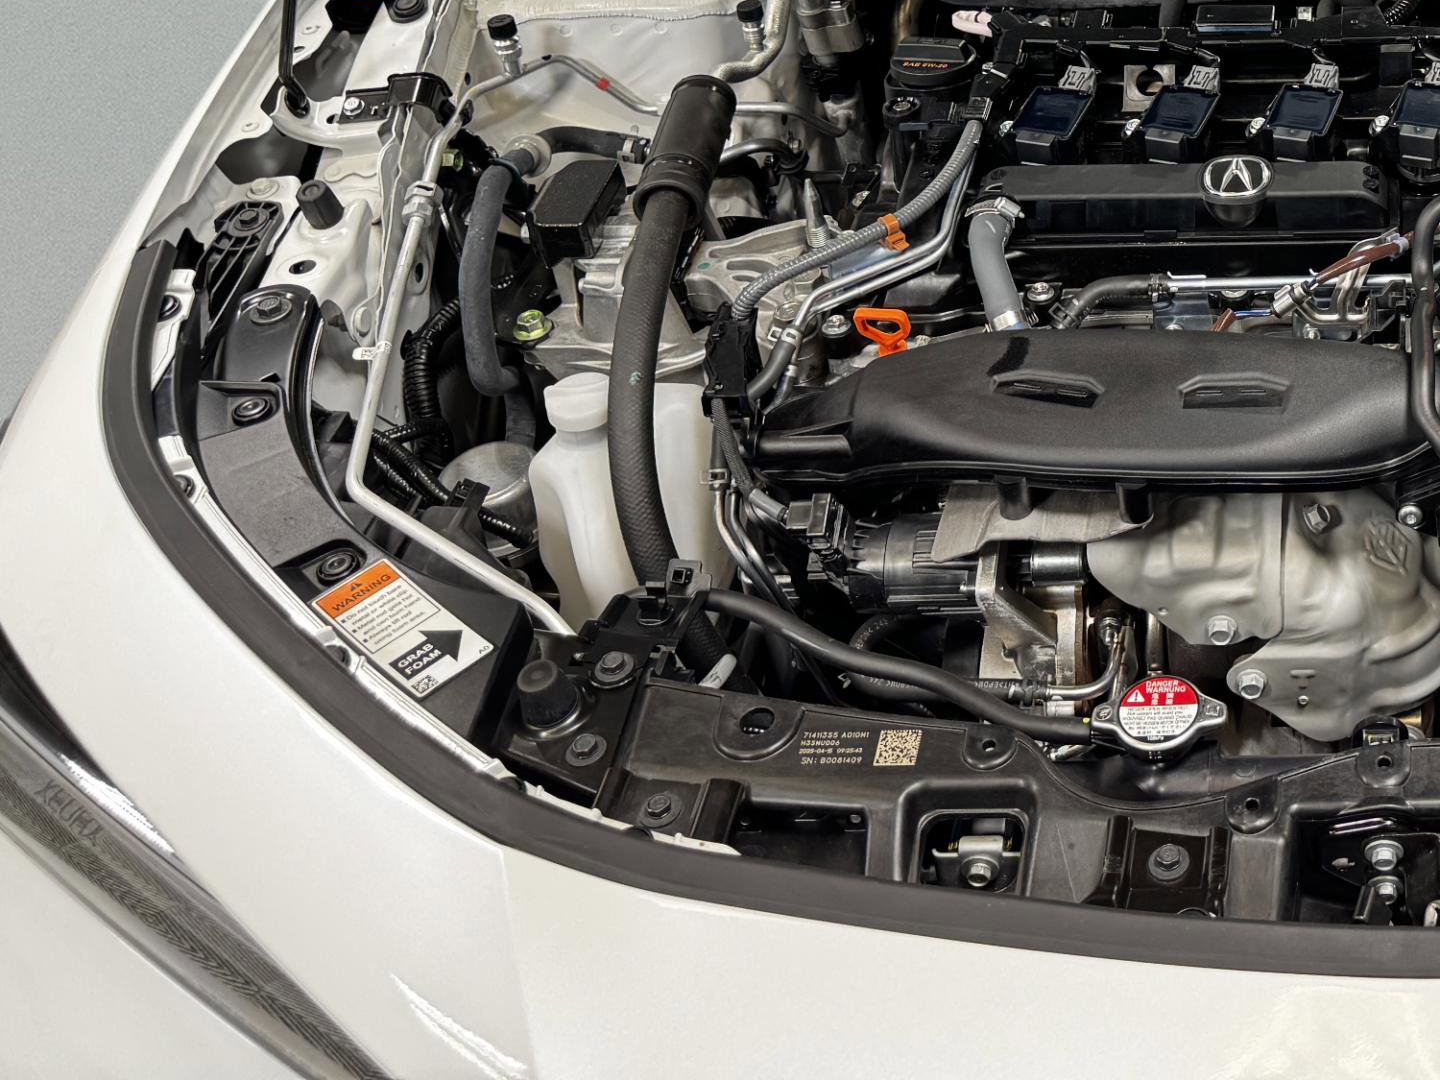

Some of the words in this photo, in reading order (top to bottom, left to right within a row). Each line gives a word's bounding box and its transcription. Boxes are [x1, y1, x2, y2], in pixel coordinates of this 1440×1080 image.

[331, 573, 392, 612] WARNING
[397, 643, 434, 669] GRAB
[404, 649, 443, 675] FOAM
[1145, 686, 1186, 694] WARNUNG
